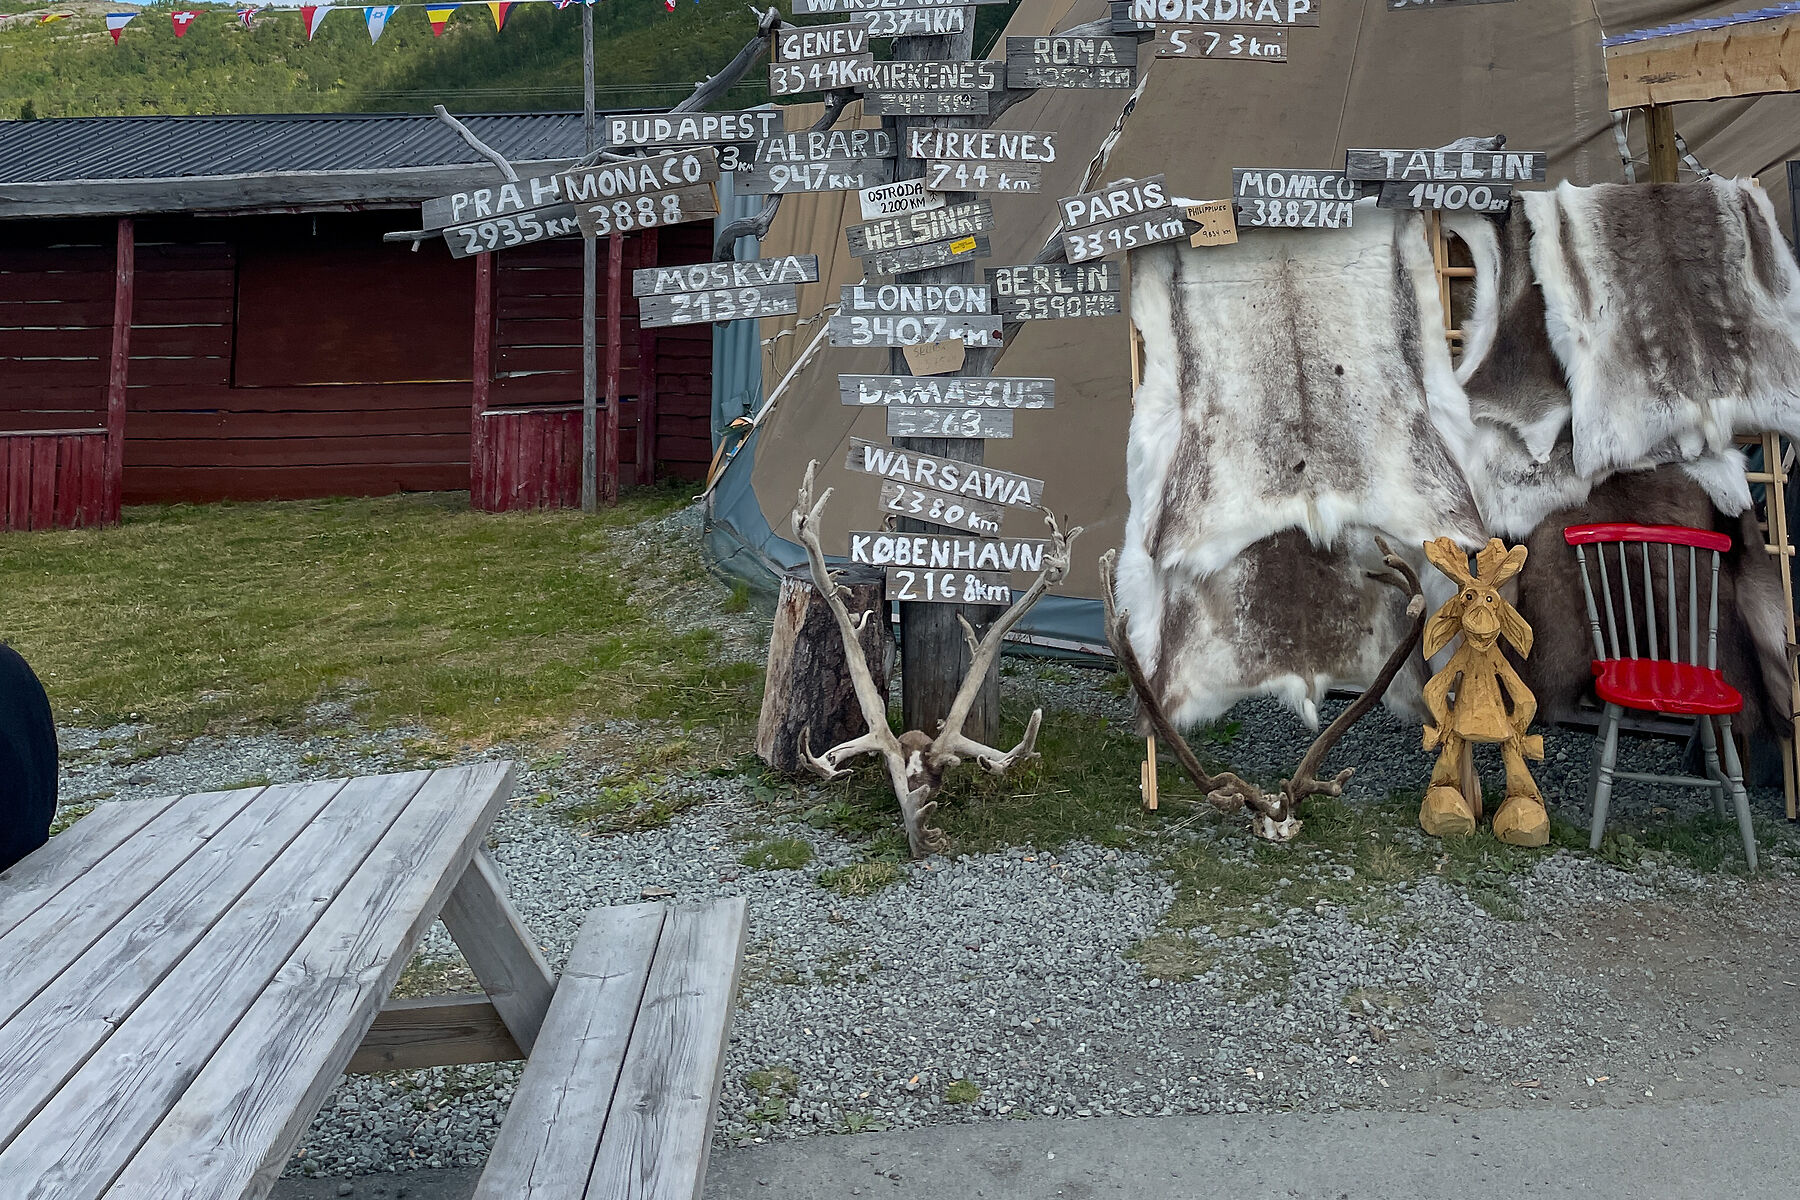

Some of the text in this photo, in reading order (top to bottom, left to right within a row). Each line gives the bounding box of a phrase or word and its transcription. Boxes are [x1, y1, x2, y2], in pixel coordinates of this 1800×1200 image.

[783, 29, 864, 60] GENEV
[1033, 38, 1118, 64] ROMA
[868, 62, 995, 89] KIRKENES
[611, 112, 777, 145] BUDAPEST
[910, 131, 1056, 163] KIRKENES
[564, 153, 702, 202] MONACO
[930, 164, 989, 188] 744
[1379, 150, 1533, 180] TALLIN
[1239, 172, 1355, 199] MONACO
[588, 194, 683, 235] 3888
[881, 199, 909, 214] 2200
[1064, 184, 1166, 227] PARIS
[864, 204, 983, 250] HELSINKI
[654, 255, 807, 294] MOSKVA
[996, 263, 1107, 296] BERLIN
[853, 284, 986, 313] LONDON
[859, 378, 1045, 409] DAMASCUS
[863, 446, 1032, 505] WARSAWA
[851, 534, 1045, 572] KØBENHAVN
